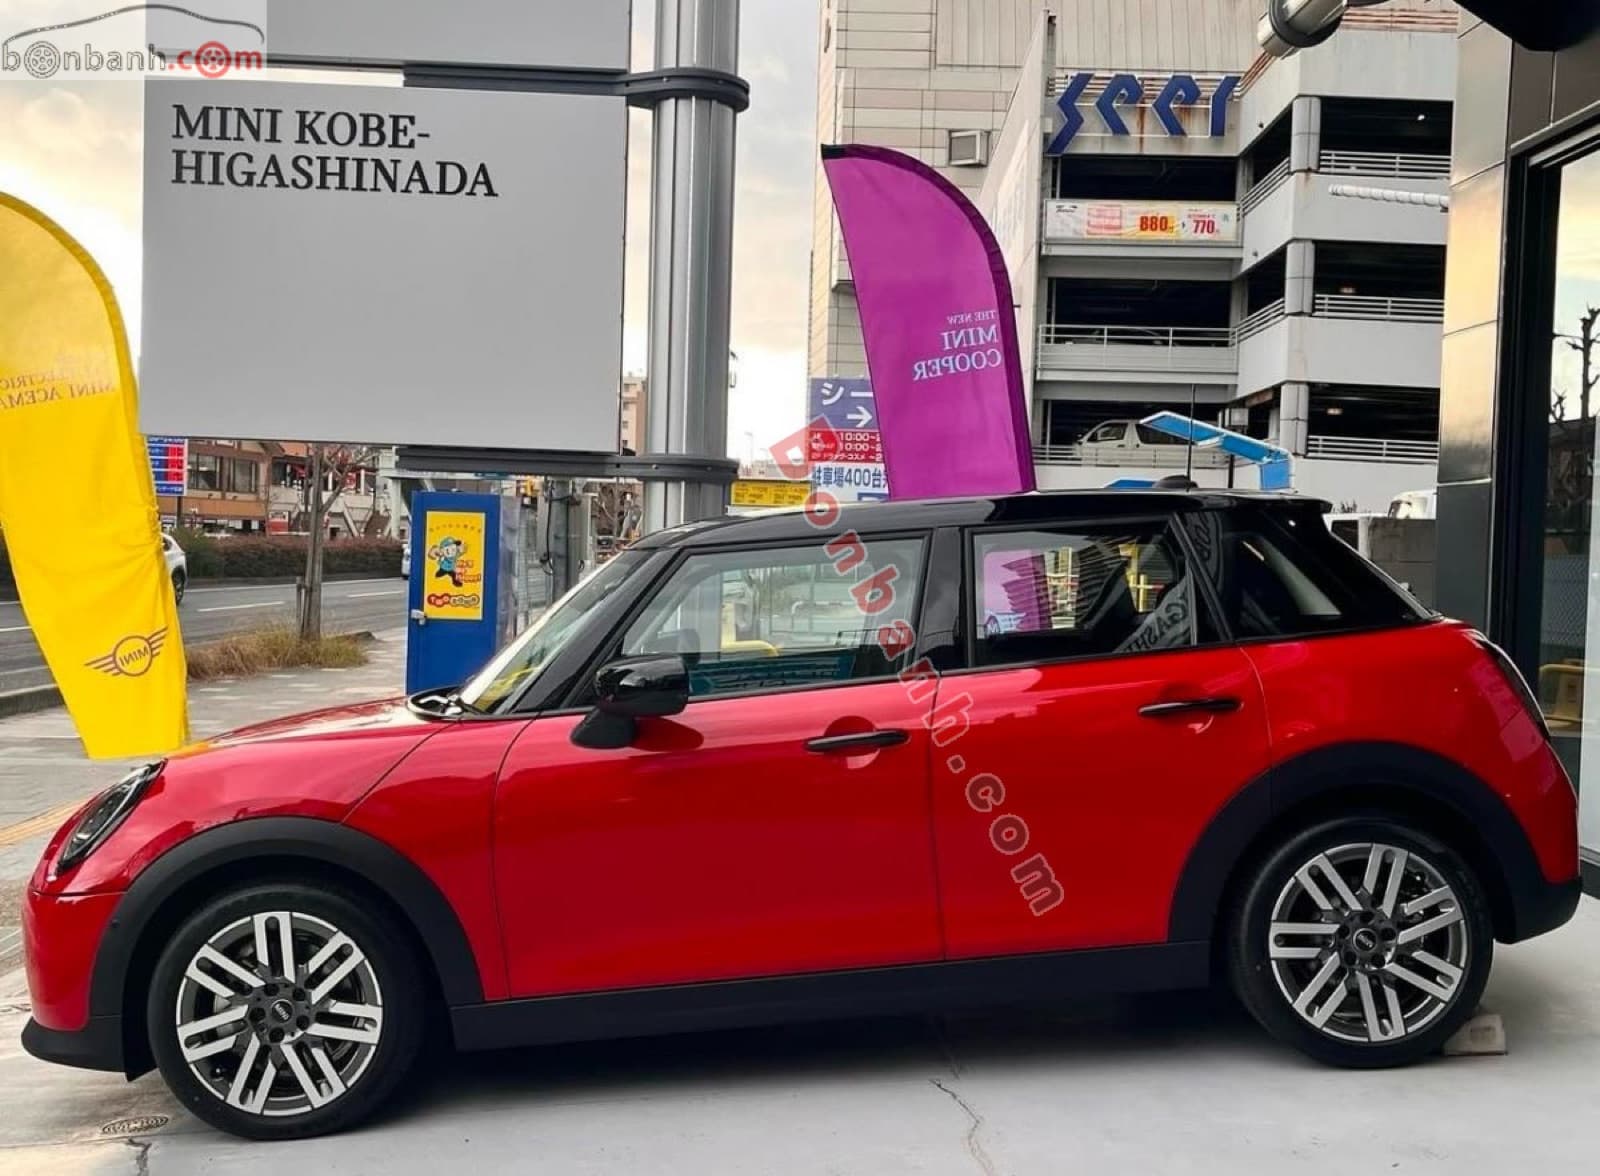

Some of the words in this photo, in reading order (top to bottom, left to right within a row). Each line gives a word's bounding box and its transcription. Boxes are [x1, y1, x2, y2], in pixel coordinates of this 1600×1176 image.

[171, 103, 282, 144] MINI
[295, 110, 430, 149] KOBE-
[171, 149, 499, 197] HIGASHINADA
